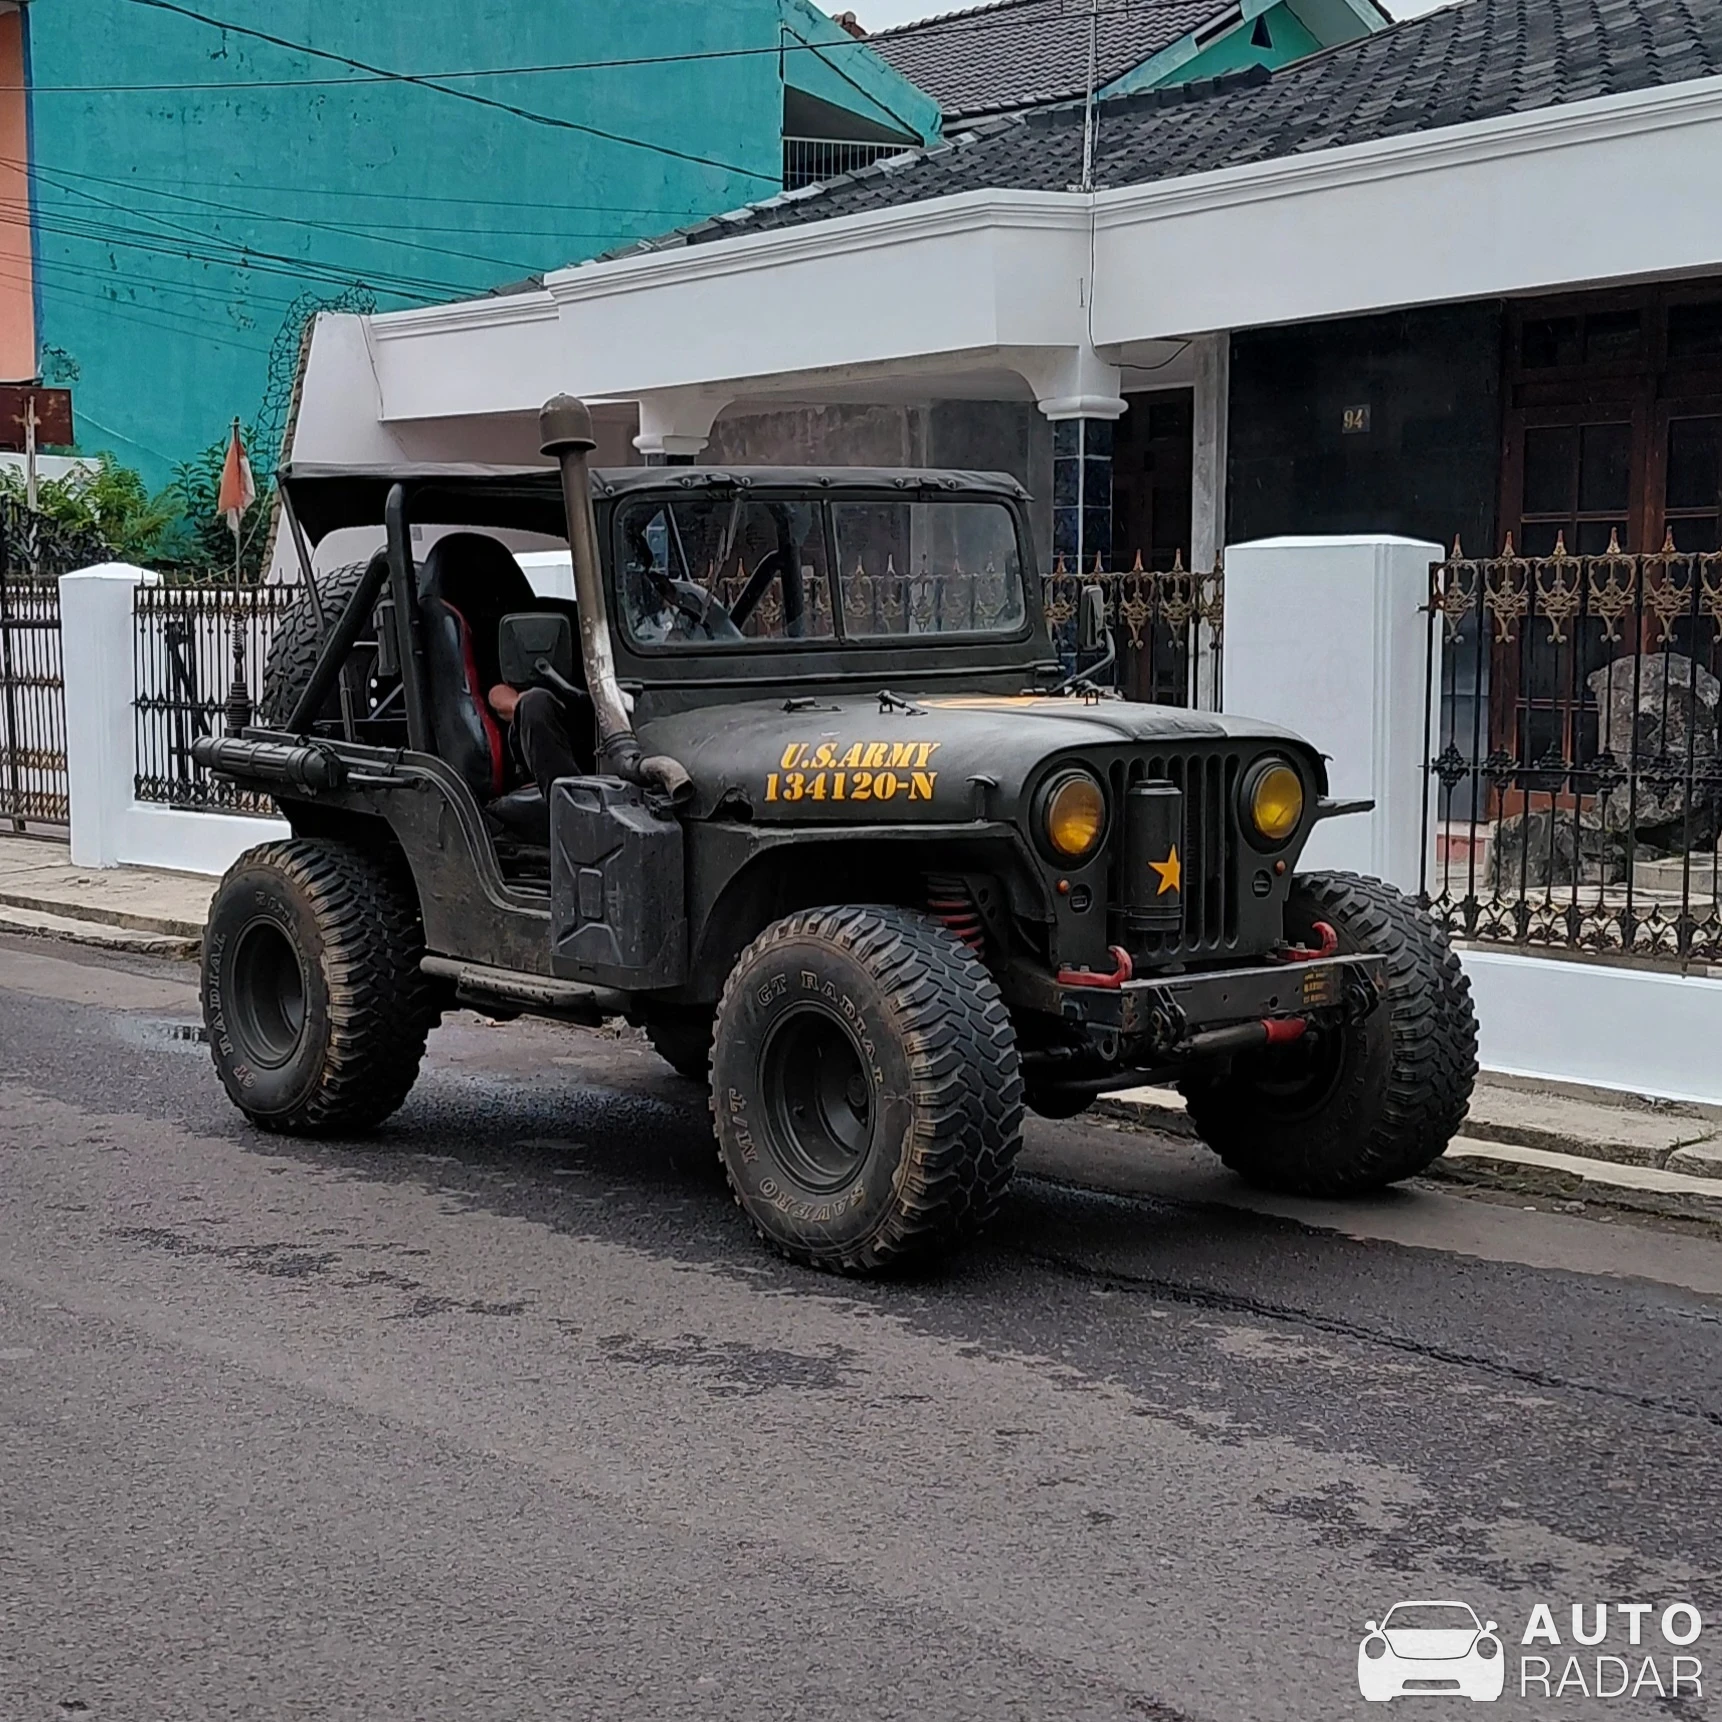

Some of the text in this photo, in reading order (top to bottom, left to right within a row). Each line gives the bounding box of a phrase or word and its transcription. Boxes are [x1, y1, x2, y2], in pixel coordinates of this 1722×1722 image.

[1343, 408, 1364, 429] 94
[764, 771, 938, 801] 134120-N
[757, 970, 885, 1092] GT RADIAL
[728, 1087, 865, 1222] SAVERO M/T
